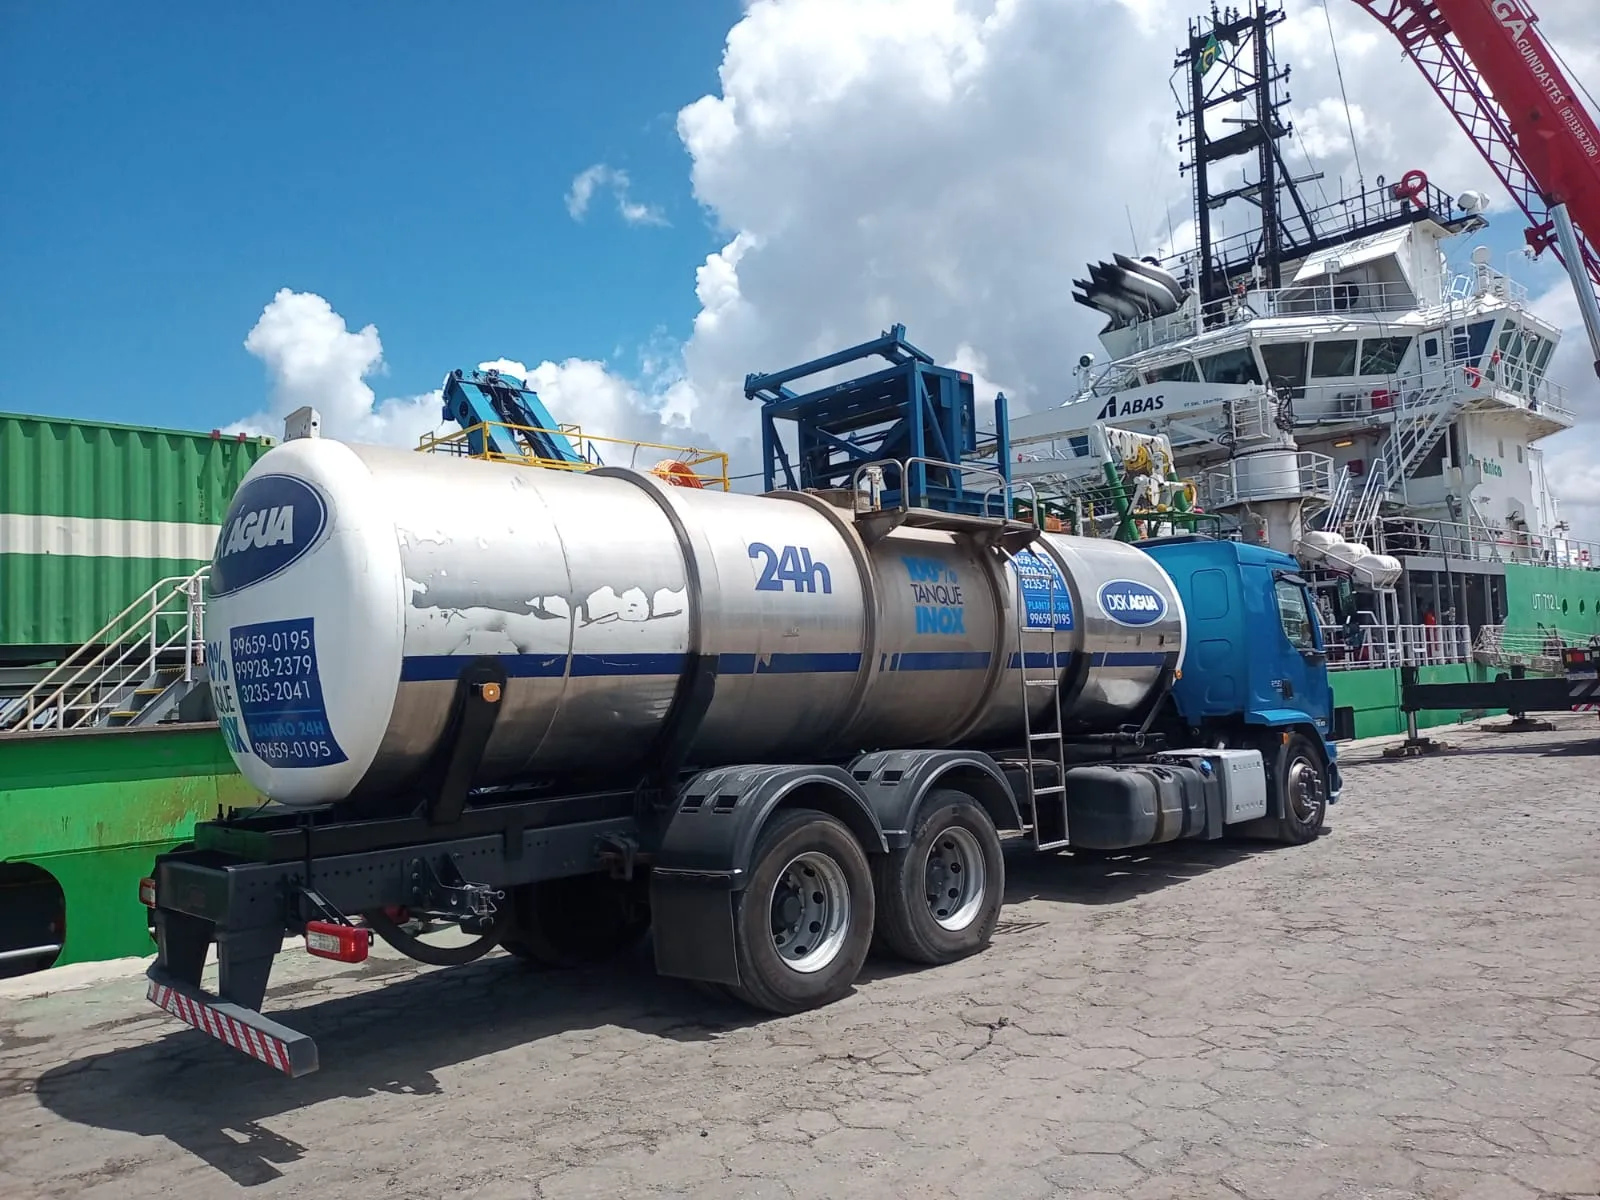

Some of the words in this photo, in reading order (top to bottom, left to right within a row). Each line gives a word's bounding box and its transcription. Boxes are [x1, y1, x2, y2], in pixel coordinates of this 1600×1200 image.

[1516, 38, 1565, 105] GUINDASTES
[1120, 395, 1164, 416] ABAS
[748, 542, 832, 594] 24h
[910, 583, 964, 606] TANQUE
[915, 606, 967, 634] INOX
[233, 630, 310, 657] 99659-0195
[235, 655, 312, 680] 99928-2379
[241, 680, 310, 703] 3235-2041
[298, 720, 325, 736] 24H
[255, 741, 331, 759] 99659-0195
